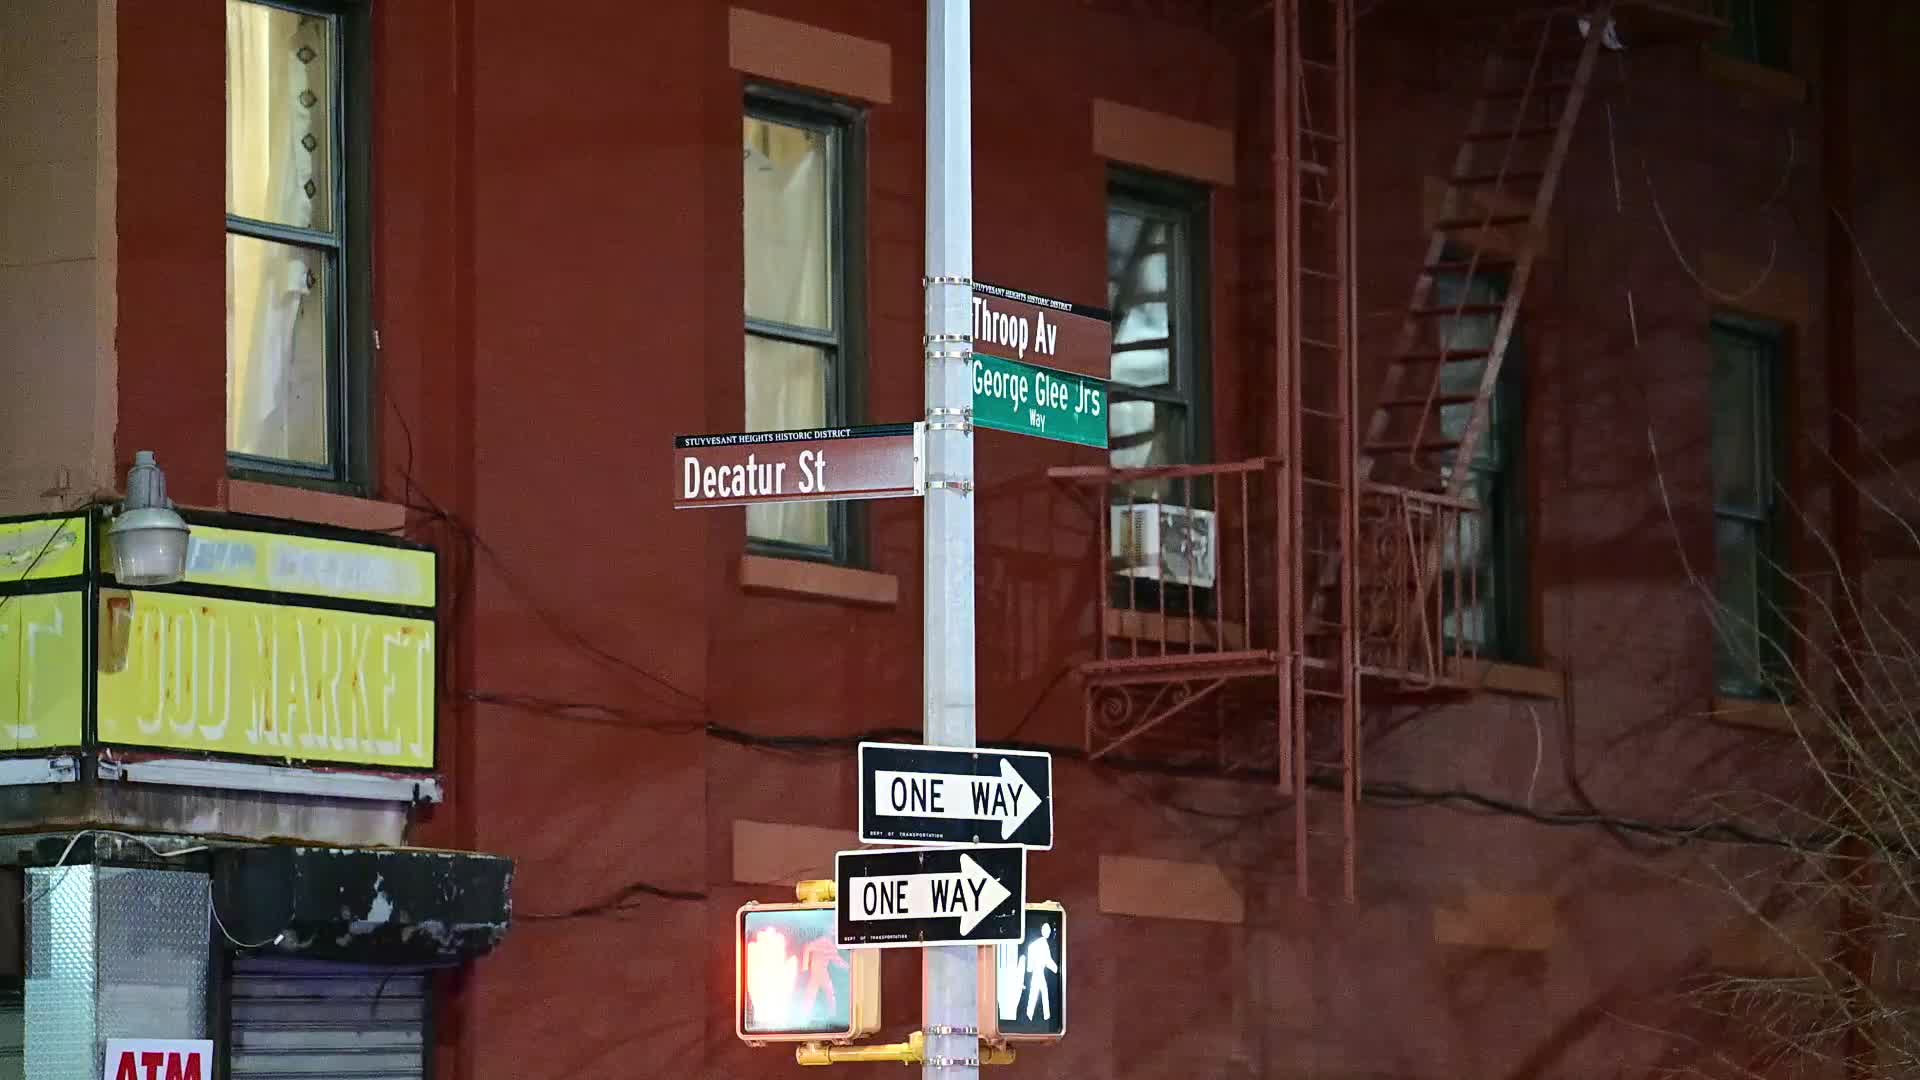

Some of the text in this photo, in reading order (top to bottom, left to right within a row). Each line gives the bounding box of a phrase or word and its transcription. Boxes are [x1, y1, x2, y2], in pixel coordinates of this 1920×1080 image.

[972, 282, 1073, 312] STUYVESANT HEIGHTS HISTORIC DISTRICT
[972, 297, 1057, 359] Throop Av
[972, 360, 1101, 416] George Glee Jrs
[685, 428, 851, 447] STUYVESANT HEIGHTS HISTORIC DISTRICT
[1029, 408, 1046, 432] Way
[684, 449, 827, 499] Decatur St
[246, 612, 432, 759] MARKET
[891, 776, 1024, 817] ONE WAY
[863, 877, 987, 916] ONE WAY
[115, 1051, 202, 1080] ATM
